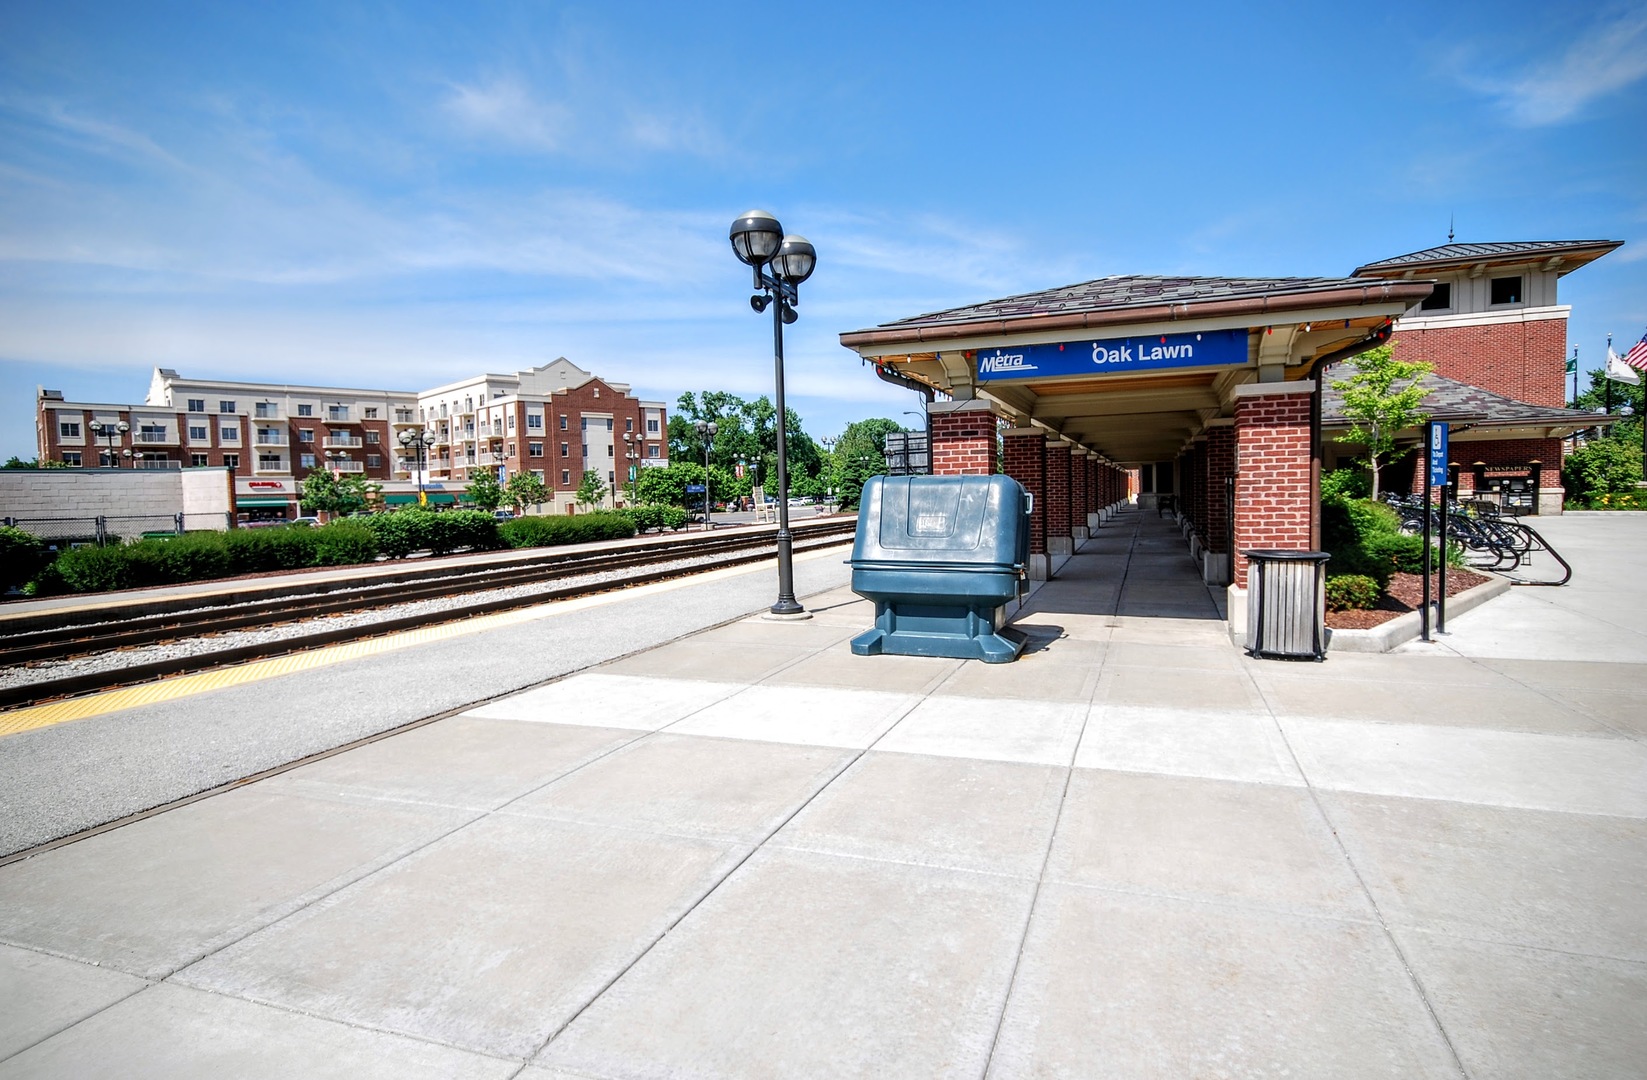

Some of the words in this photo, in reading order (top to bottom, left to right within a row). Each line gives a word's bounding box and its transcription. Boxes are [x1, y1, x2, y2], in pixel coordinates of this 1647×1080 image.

[980, 353, 1024, 373] Metra
[1092, 346, 1132, 364] Oak
[1139, 344, 1193, 362] Lawn
